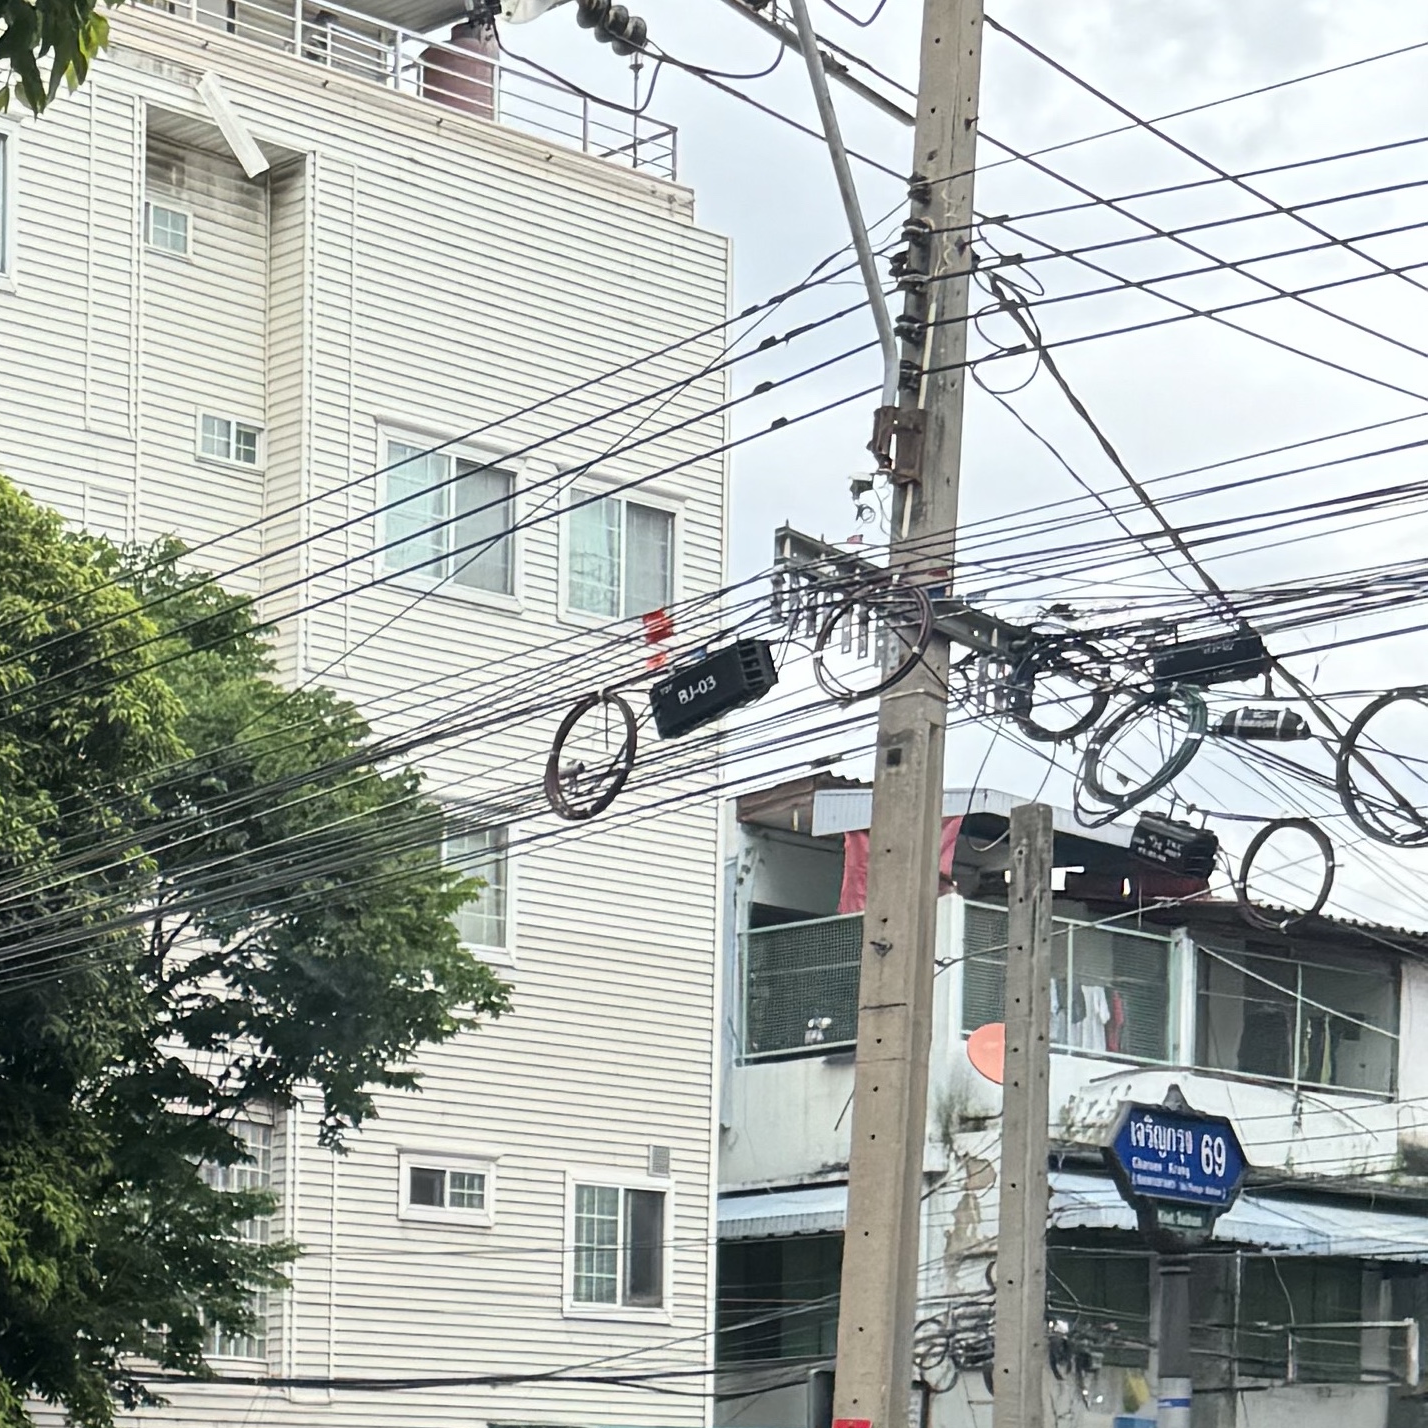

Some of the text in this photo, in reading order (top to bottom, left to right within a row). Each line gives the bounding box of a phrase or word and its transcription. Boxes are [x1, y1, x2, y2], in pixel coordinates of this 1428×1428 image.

[678, 675, 716, 704] BJ-03
[1130, 1115, 1226, 1177] เจริญกรุง 69
